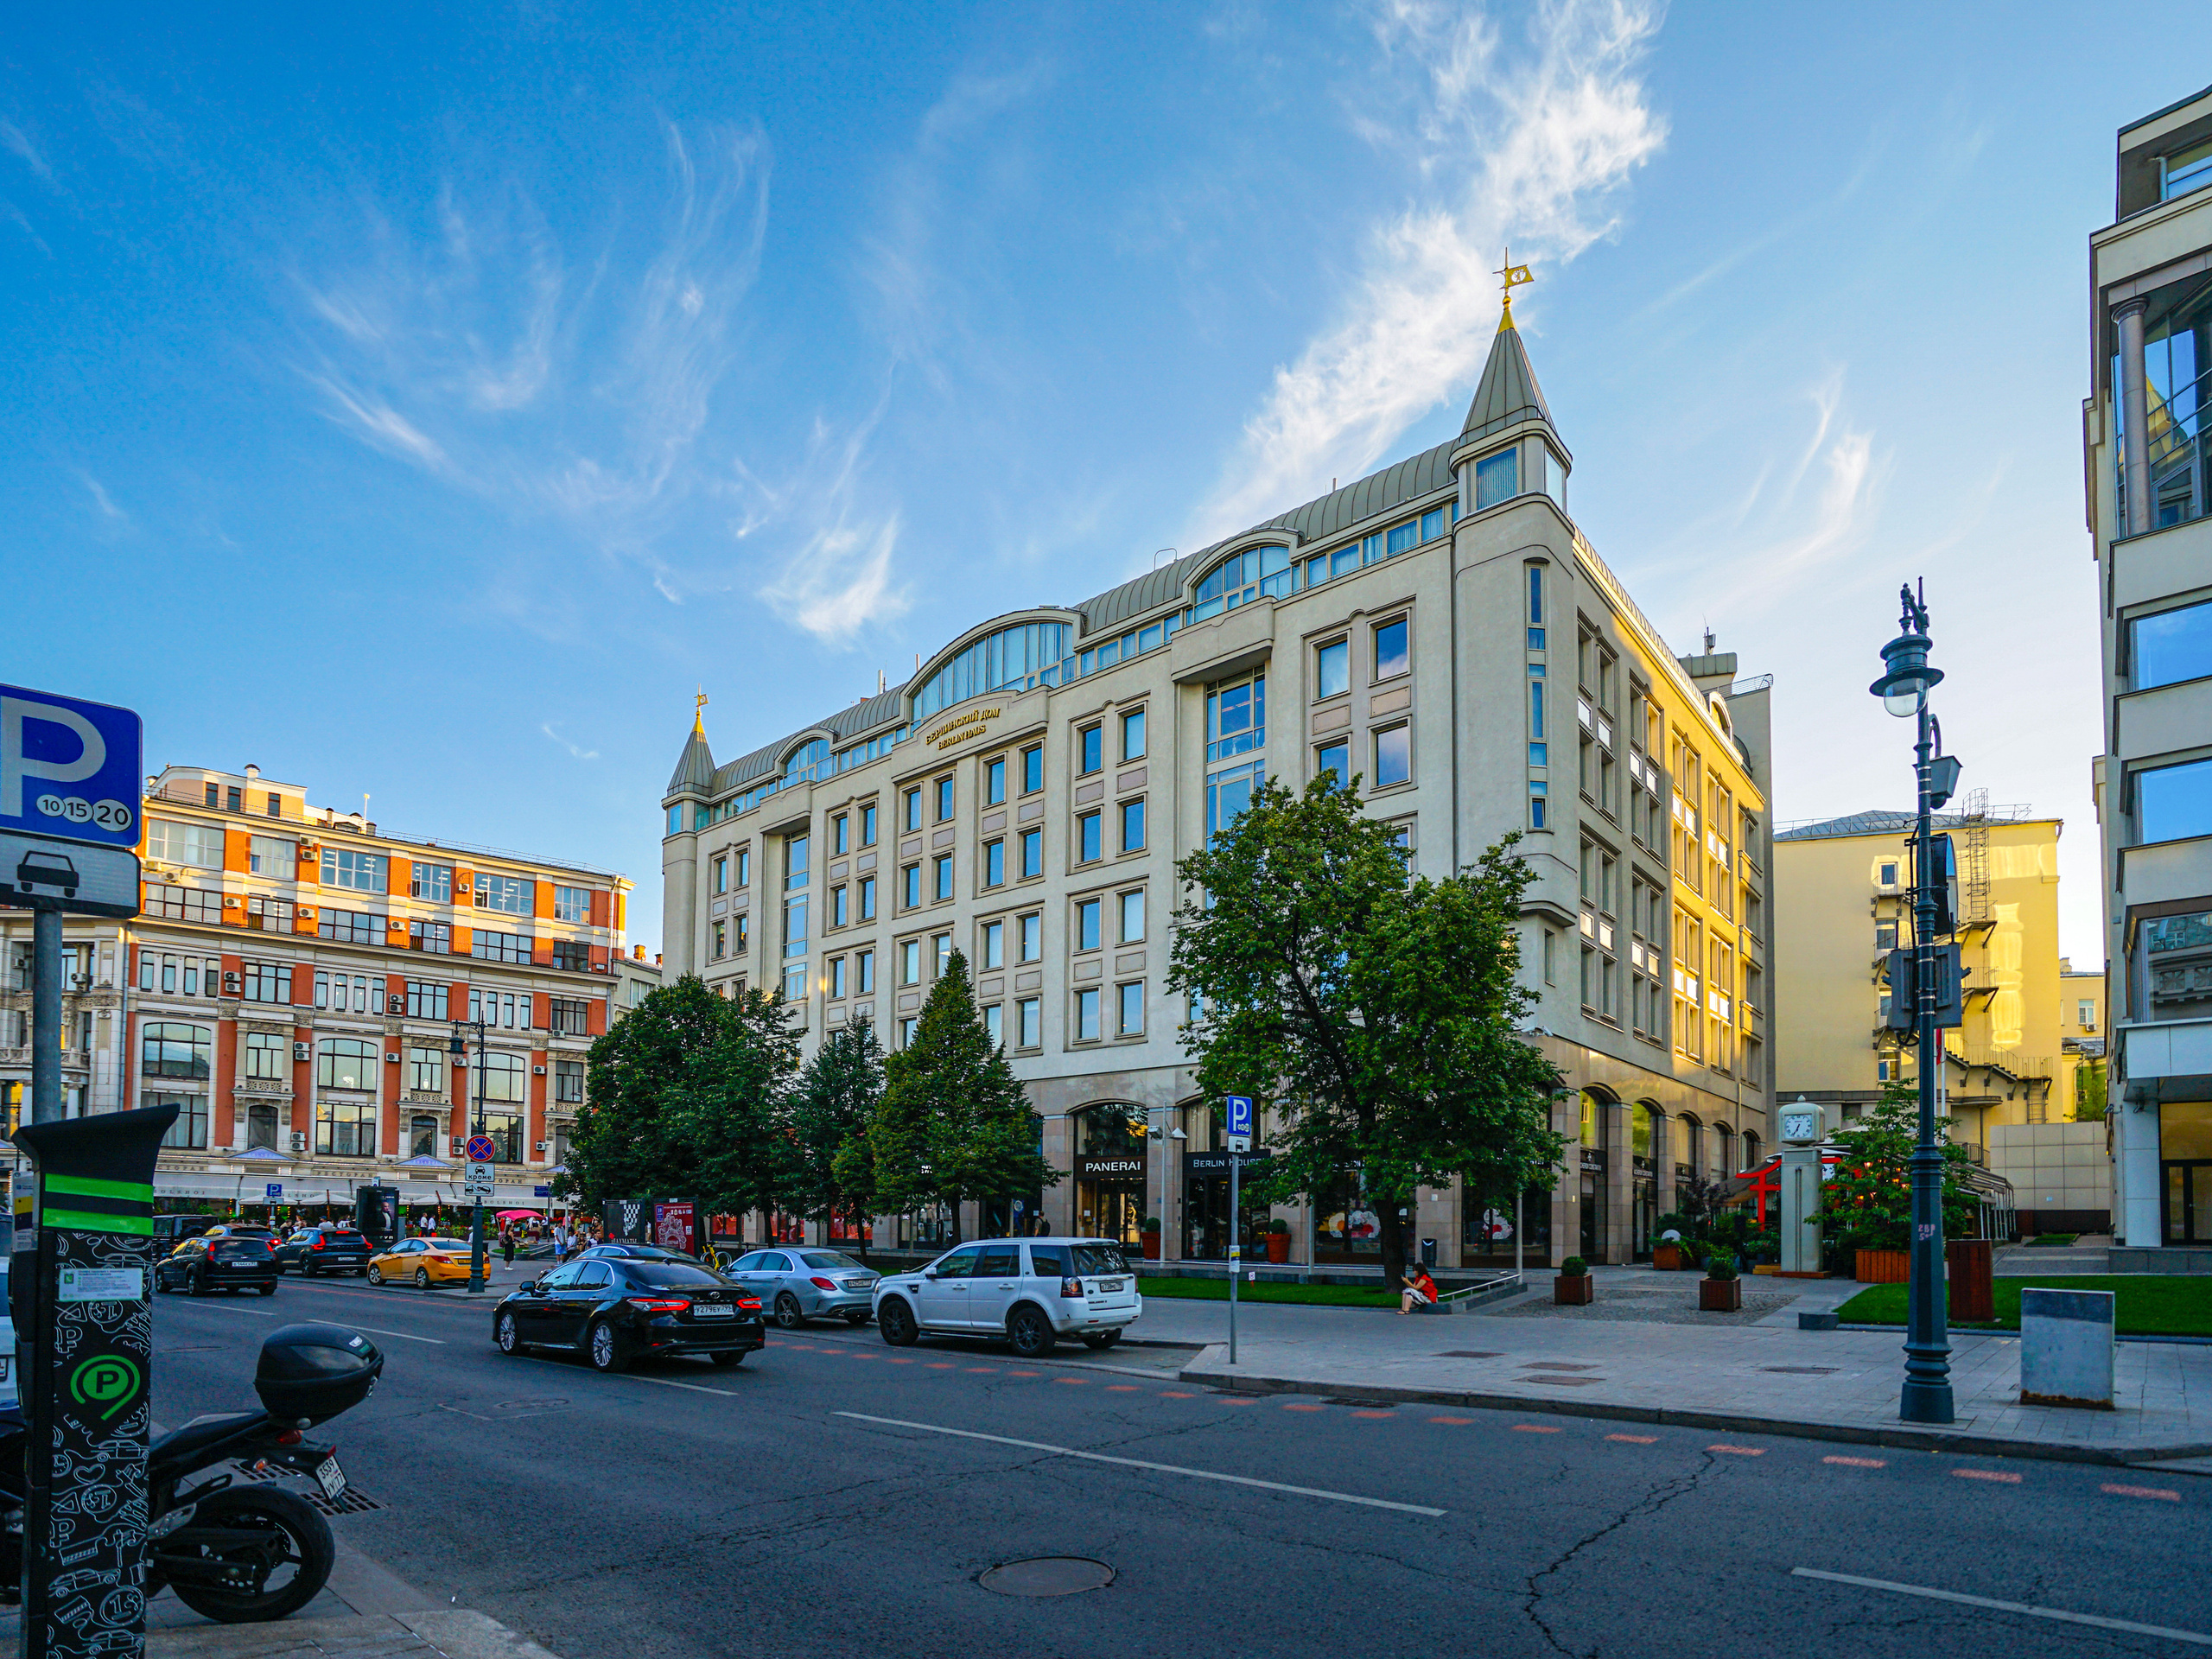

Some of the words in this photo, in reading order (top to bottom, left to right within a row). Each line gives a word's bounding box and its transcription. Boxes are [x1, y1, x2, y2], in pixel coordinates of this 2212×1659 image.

[925, 709, 979, 745] БЕРЛИНСКИЙ
[980, 708, 1001, 722] ДОМ
[938, 732, 965, 750] BERLIN
[965, 724, 986, 741] HAUS
[0, 695, 106, 817] P
[43, 799, 60, 812] 10
[67, 802, 87, 817] 15
[97, 804, 129, 825] 20
[1233, 1098, 1248, 1132] P
[1085, 1160, 1141, 1172] PANERAI
[1193, 1159, 1225, 1168] BERLIN
[270, 1185, 280, 1196] P
[96, 1370, 119, 1394] P
[319, 1459, 335, 1479] 3539
